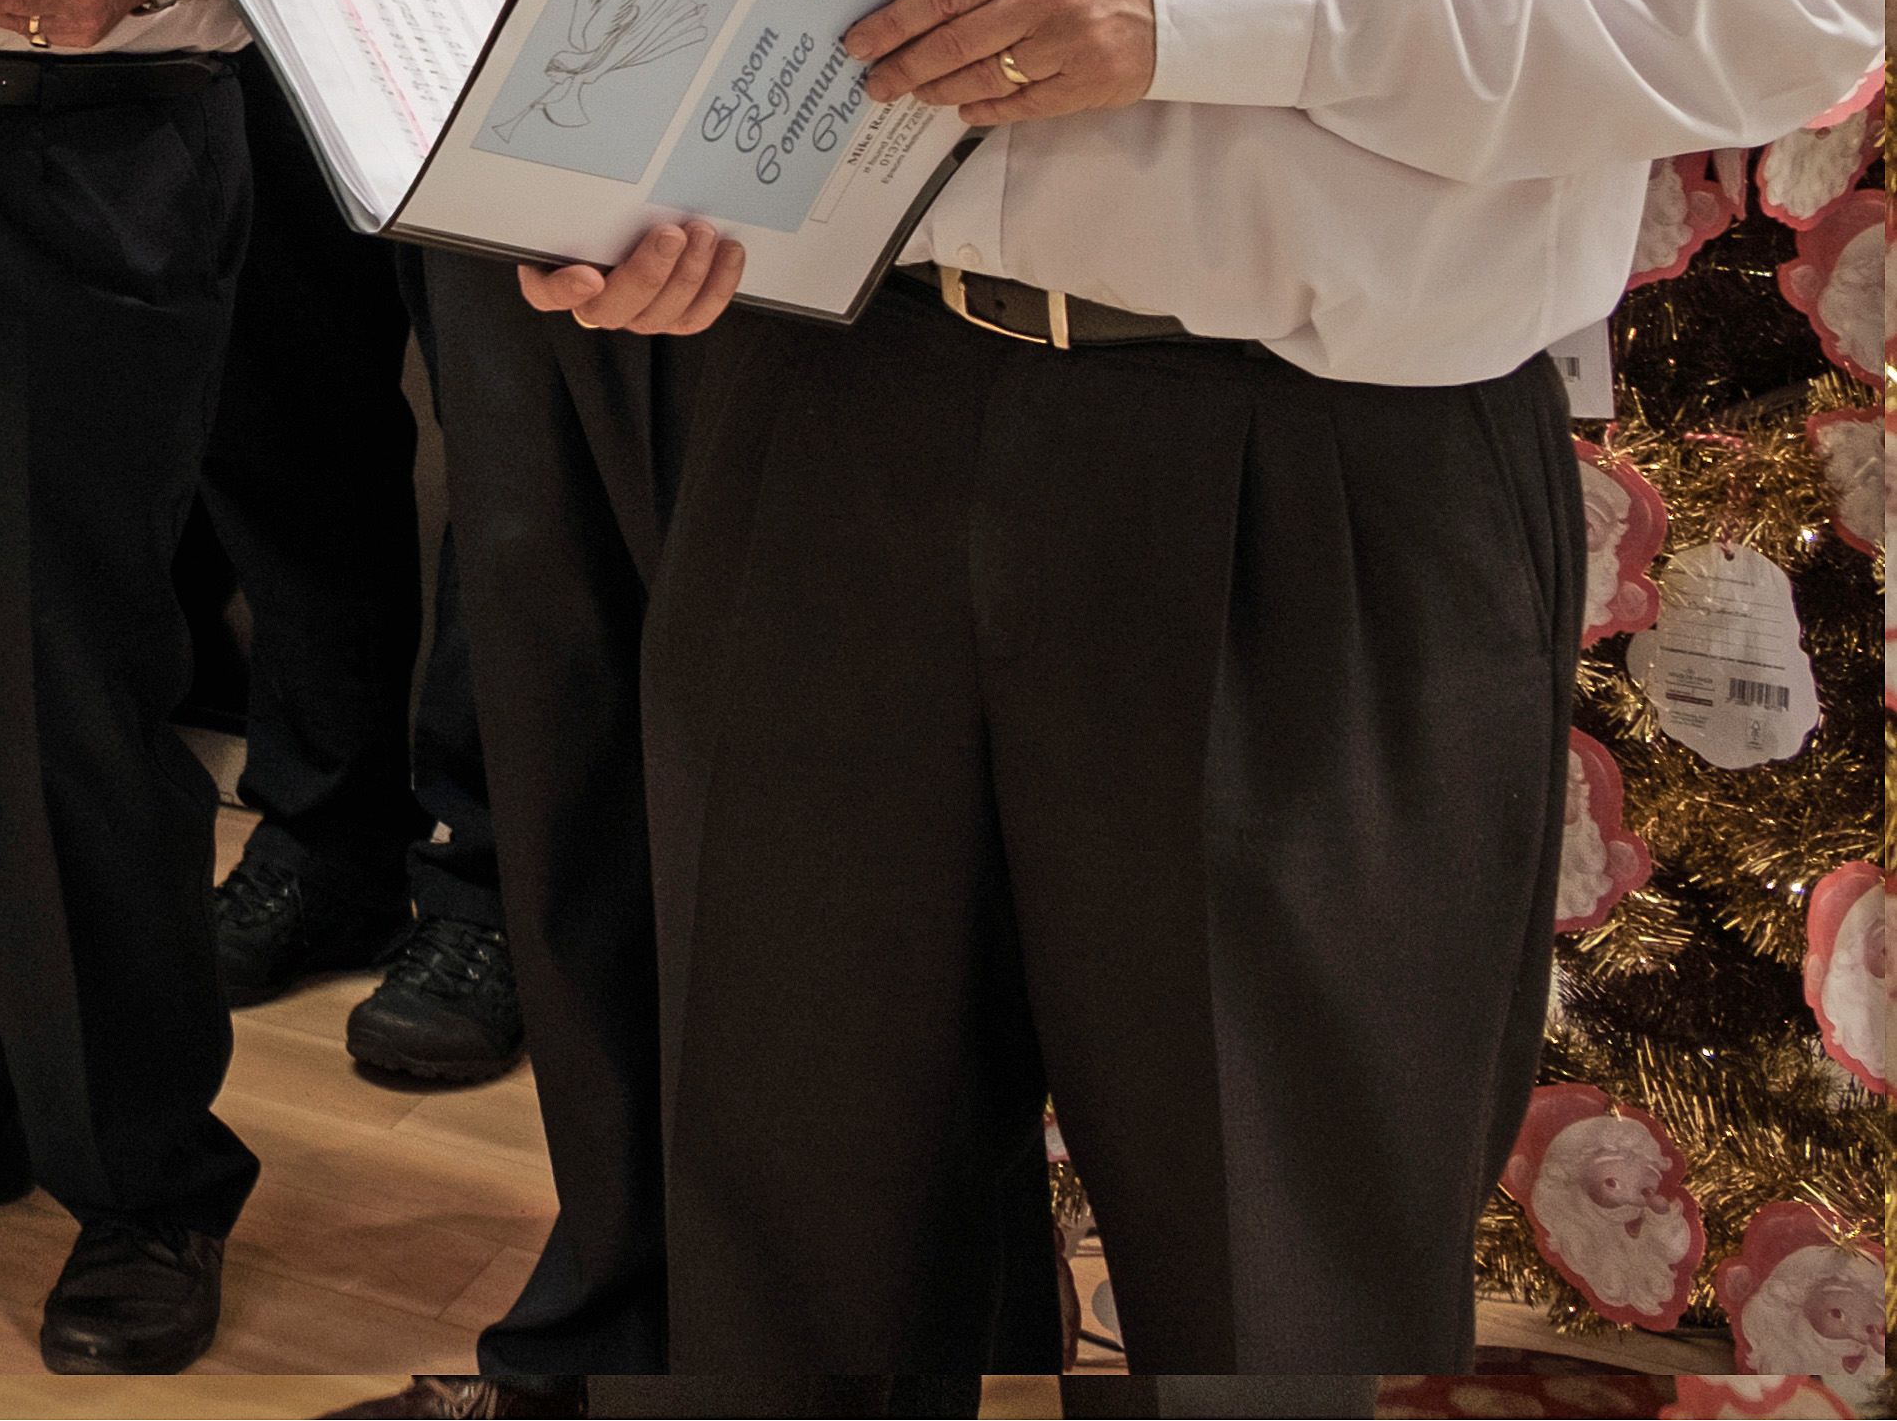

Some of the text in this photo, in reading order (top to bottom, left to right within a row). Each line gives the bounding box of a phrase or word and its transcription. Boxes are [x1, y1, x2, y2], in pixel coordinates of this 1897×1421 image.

[702, 27, 780, 143] Epsom
[735, 32, 815, 153] Rejoice
[756, 36, 850, 185] Communi
[812, 67, 868, 153] Choi
[847, 133, 873, 166] Mike
[880, 133, 907, 167] 01372
